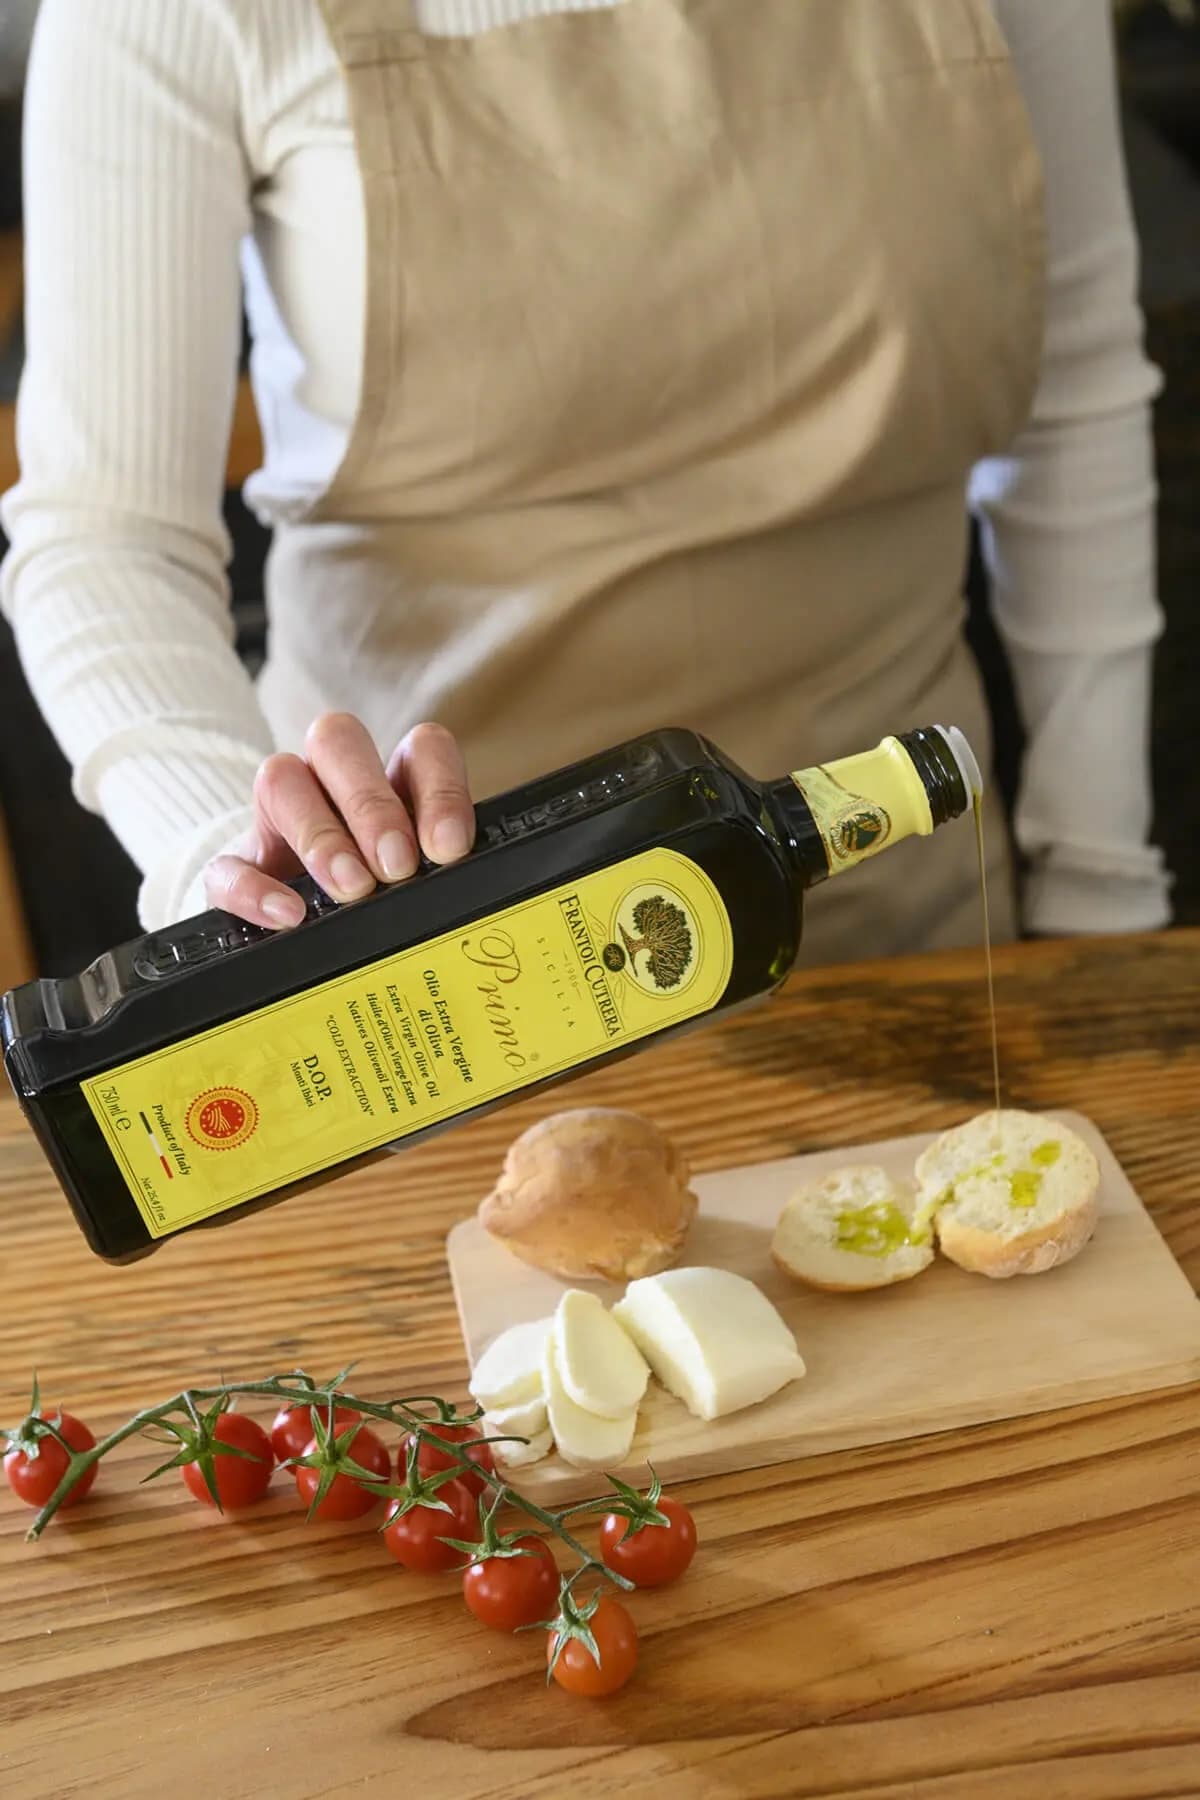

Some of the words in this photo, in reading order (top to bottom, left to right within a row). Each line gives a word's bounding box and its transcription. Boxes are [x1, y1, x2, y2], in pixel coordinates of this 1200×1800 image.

[537, 937, 577, 1028] SICILIA
[558, 893, 598, 965] FRANTOI
[583, 964, 623, 1038] CUTRERA
[417, 1009, 432, 1023] di
[422, 969, 441, 998] Olio
[434, 1000, 455, 1035] Extra
[449, 1036, 475, 1084] Vergine
[346, 1000, 370, 1040] Natives
[364, 1041, 390, 1084] Olivenöl
[382, 1086, 400, 1114] Extra
[366, 992, 384, 1019] Huile
[376, 1019, 396, 1051] d'Olive
[390, 1051, 408, 1081] Vierge
[401, 1079, 418, 1106] Extra
[386, 984, 404, 1014] Extra
[400, 1016, 419, 1049] Virgin
[413, 1051, 430, 1079] Olive
[426, 1080, 441, 1099] Oil
[424, 1024, 445, 1059] Oliva
[290, 1061, 308, 1087] Monti
[302, 1087, 317, 1107] Iblei
[303, 1054, 332, 1101] D.O.P.
[326, 1014, 345, 1048] "COLD
[338, 1048, 375, 1117] EXTRACTION"
[100, 1086, 121, 1106] 750
[108, 1101, 128, 1117] ml
[152, 1103, 177, 1142] Product
[168, 1140, 183, 1157] of
[174, 1150, 192, 1176] Italy
[141, 1176, 153, 1191] Net
